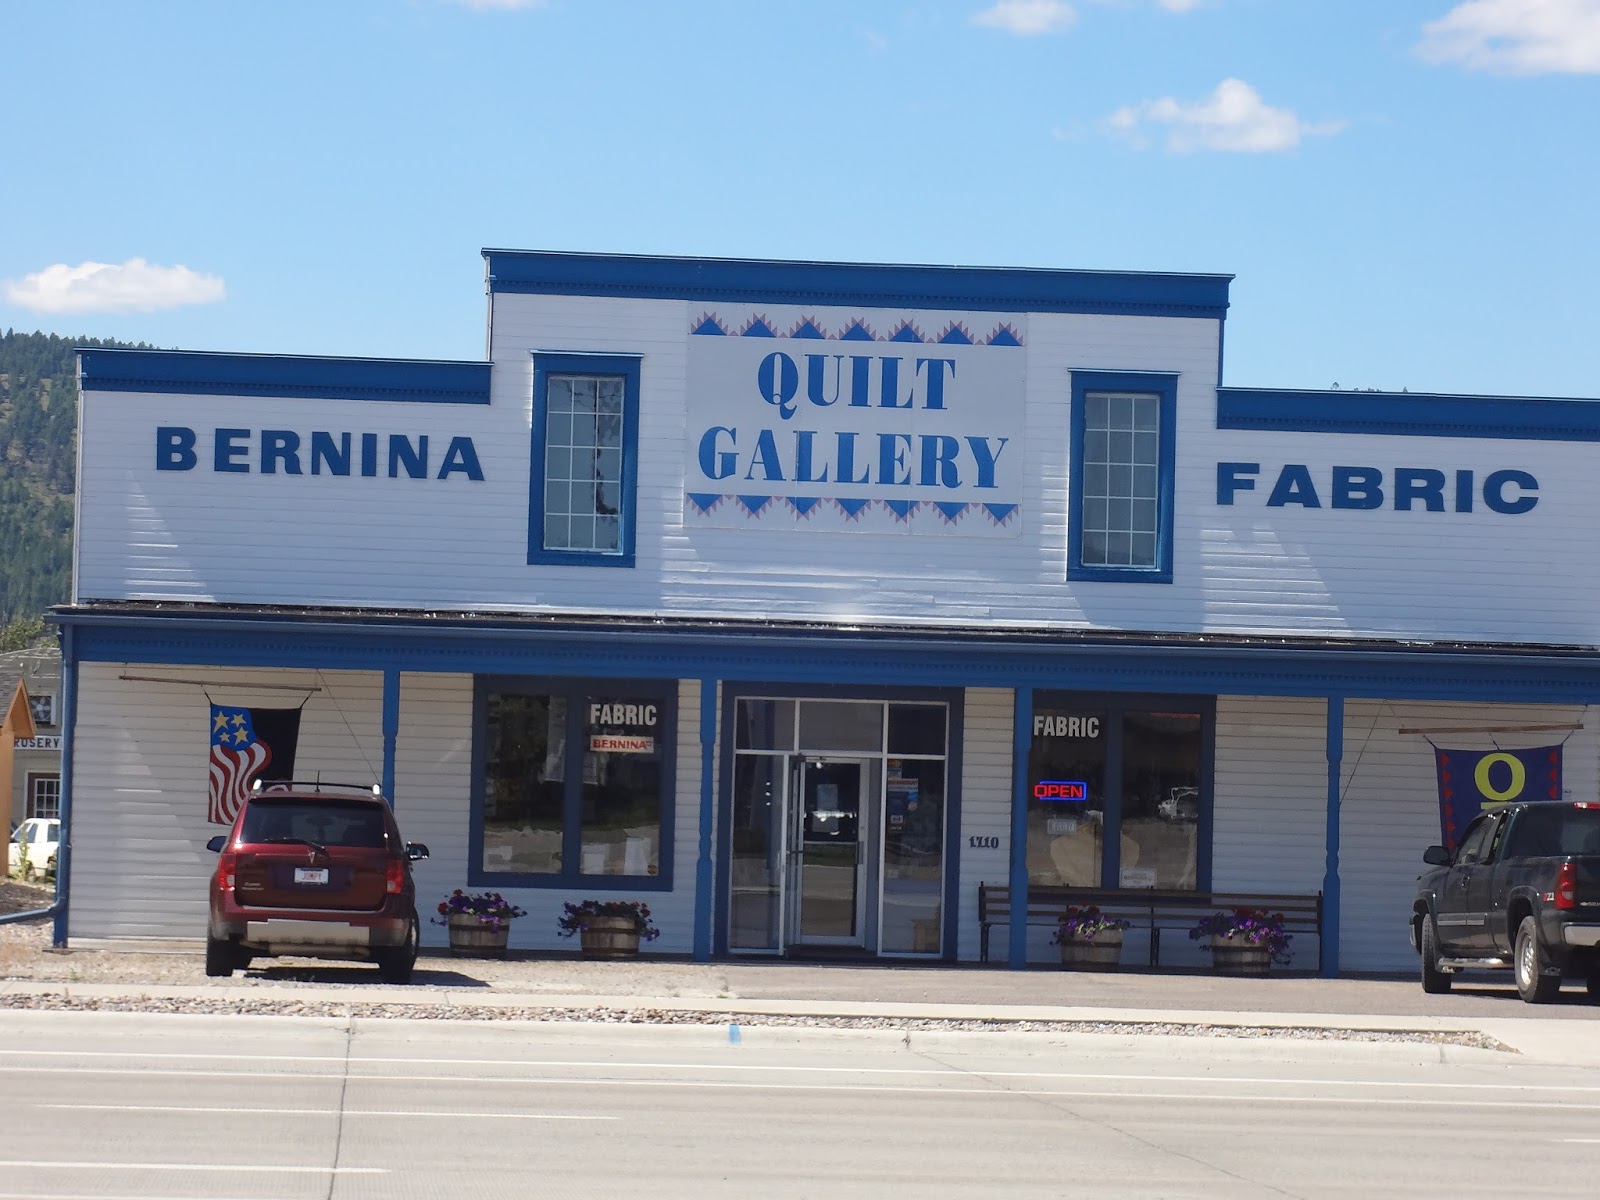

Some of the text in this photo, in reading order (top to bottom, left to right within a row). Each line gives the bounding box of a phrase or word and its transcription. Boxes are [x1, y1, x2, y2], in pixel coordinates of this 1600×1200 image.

[758, 352, 956, 420] QUILT
[156, 426, 486, 481] BERNINA
[698, 426, 1010, 489] GALLERY
[1216, 462, 1540, 515] FABRIC
[590, 703, 657, 726] FABRIC
[1033, 715, 1100, 738] FABRIC
[592, 738, 648, 750] BERNINA
[1033, 784, 1083, 798] OPEN
[968, 835, 1000, 849] 1710
